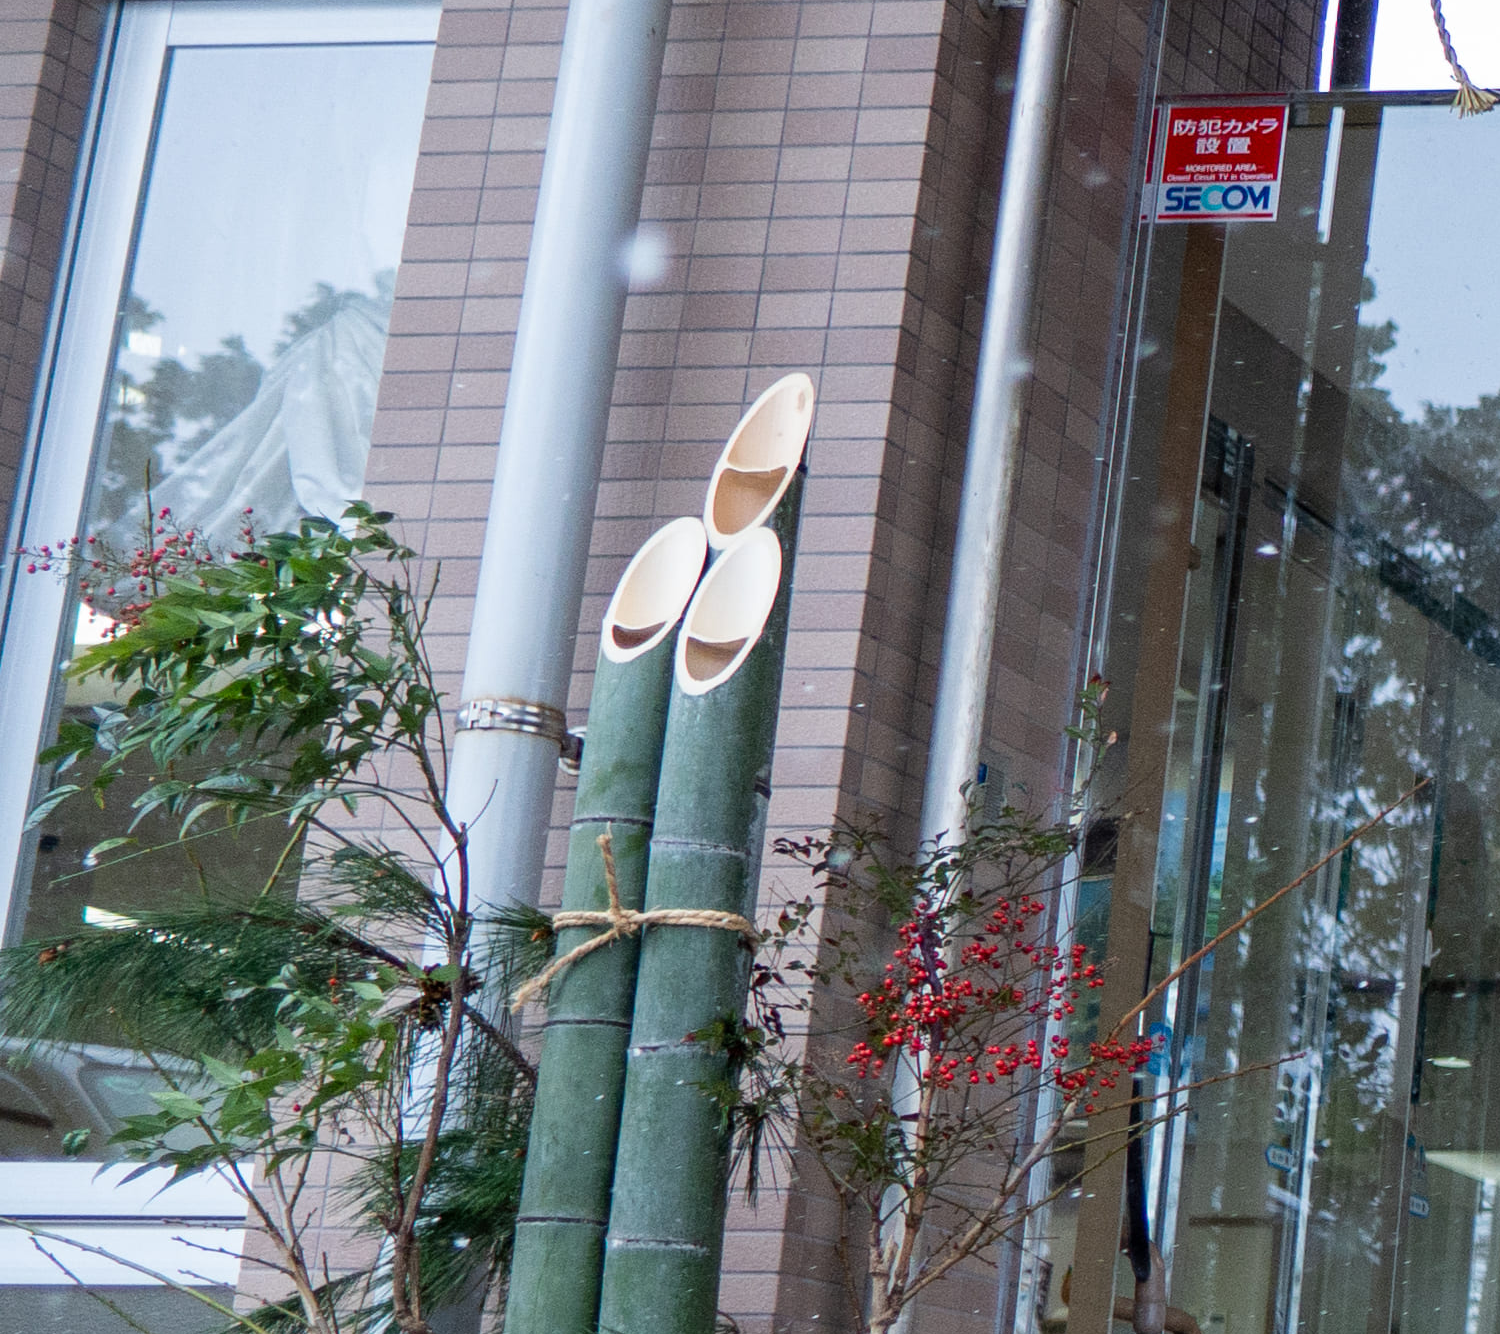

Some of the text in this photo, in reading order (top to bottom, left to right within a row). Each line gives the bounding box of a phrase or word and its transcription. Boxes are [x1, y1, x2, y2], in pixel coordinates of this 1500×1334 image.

[1173, 118, 1279, 136] 防犯カメラ
[1196, 137, 1251, 154] 設置
[1185, 163, 1257, 172] MONITORED AREA
[1165, 185, 1270, 211] SECOM
